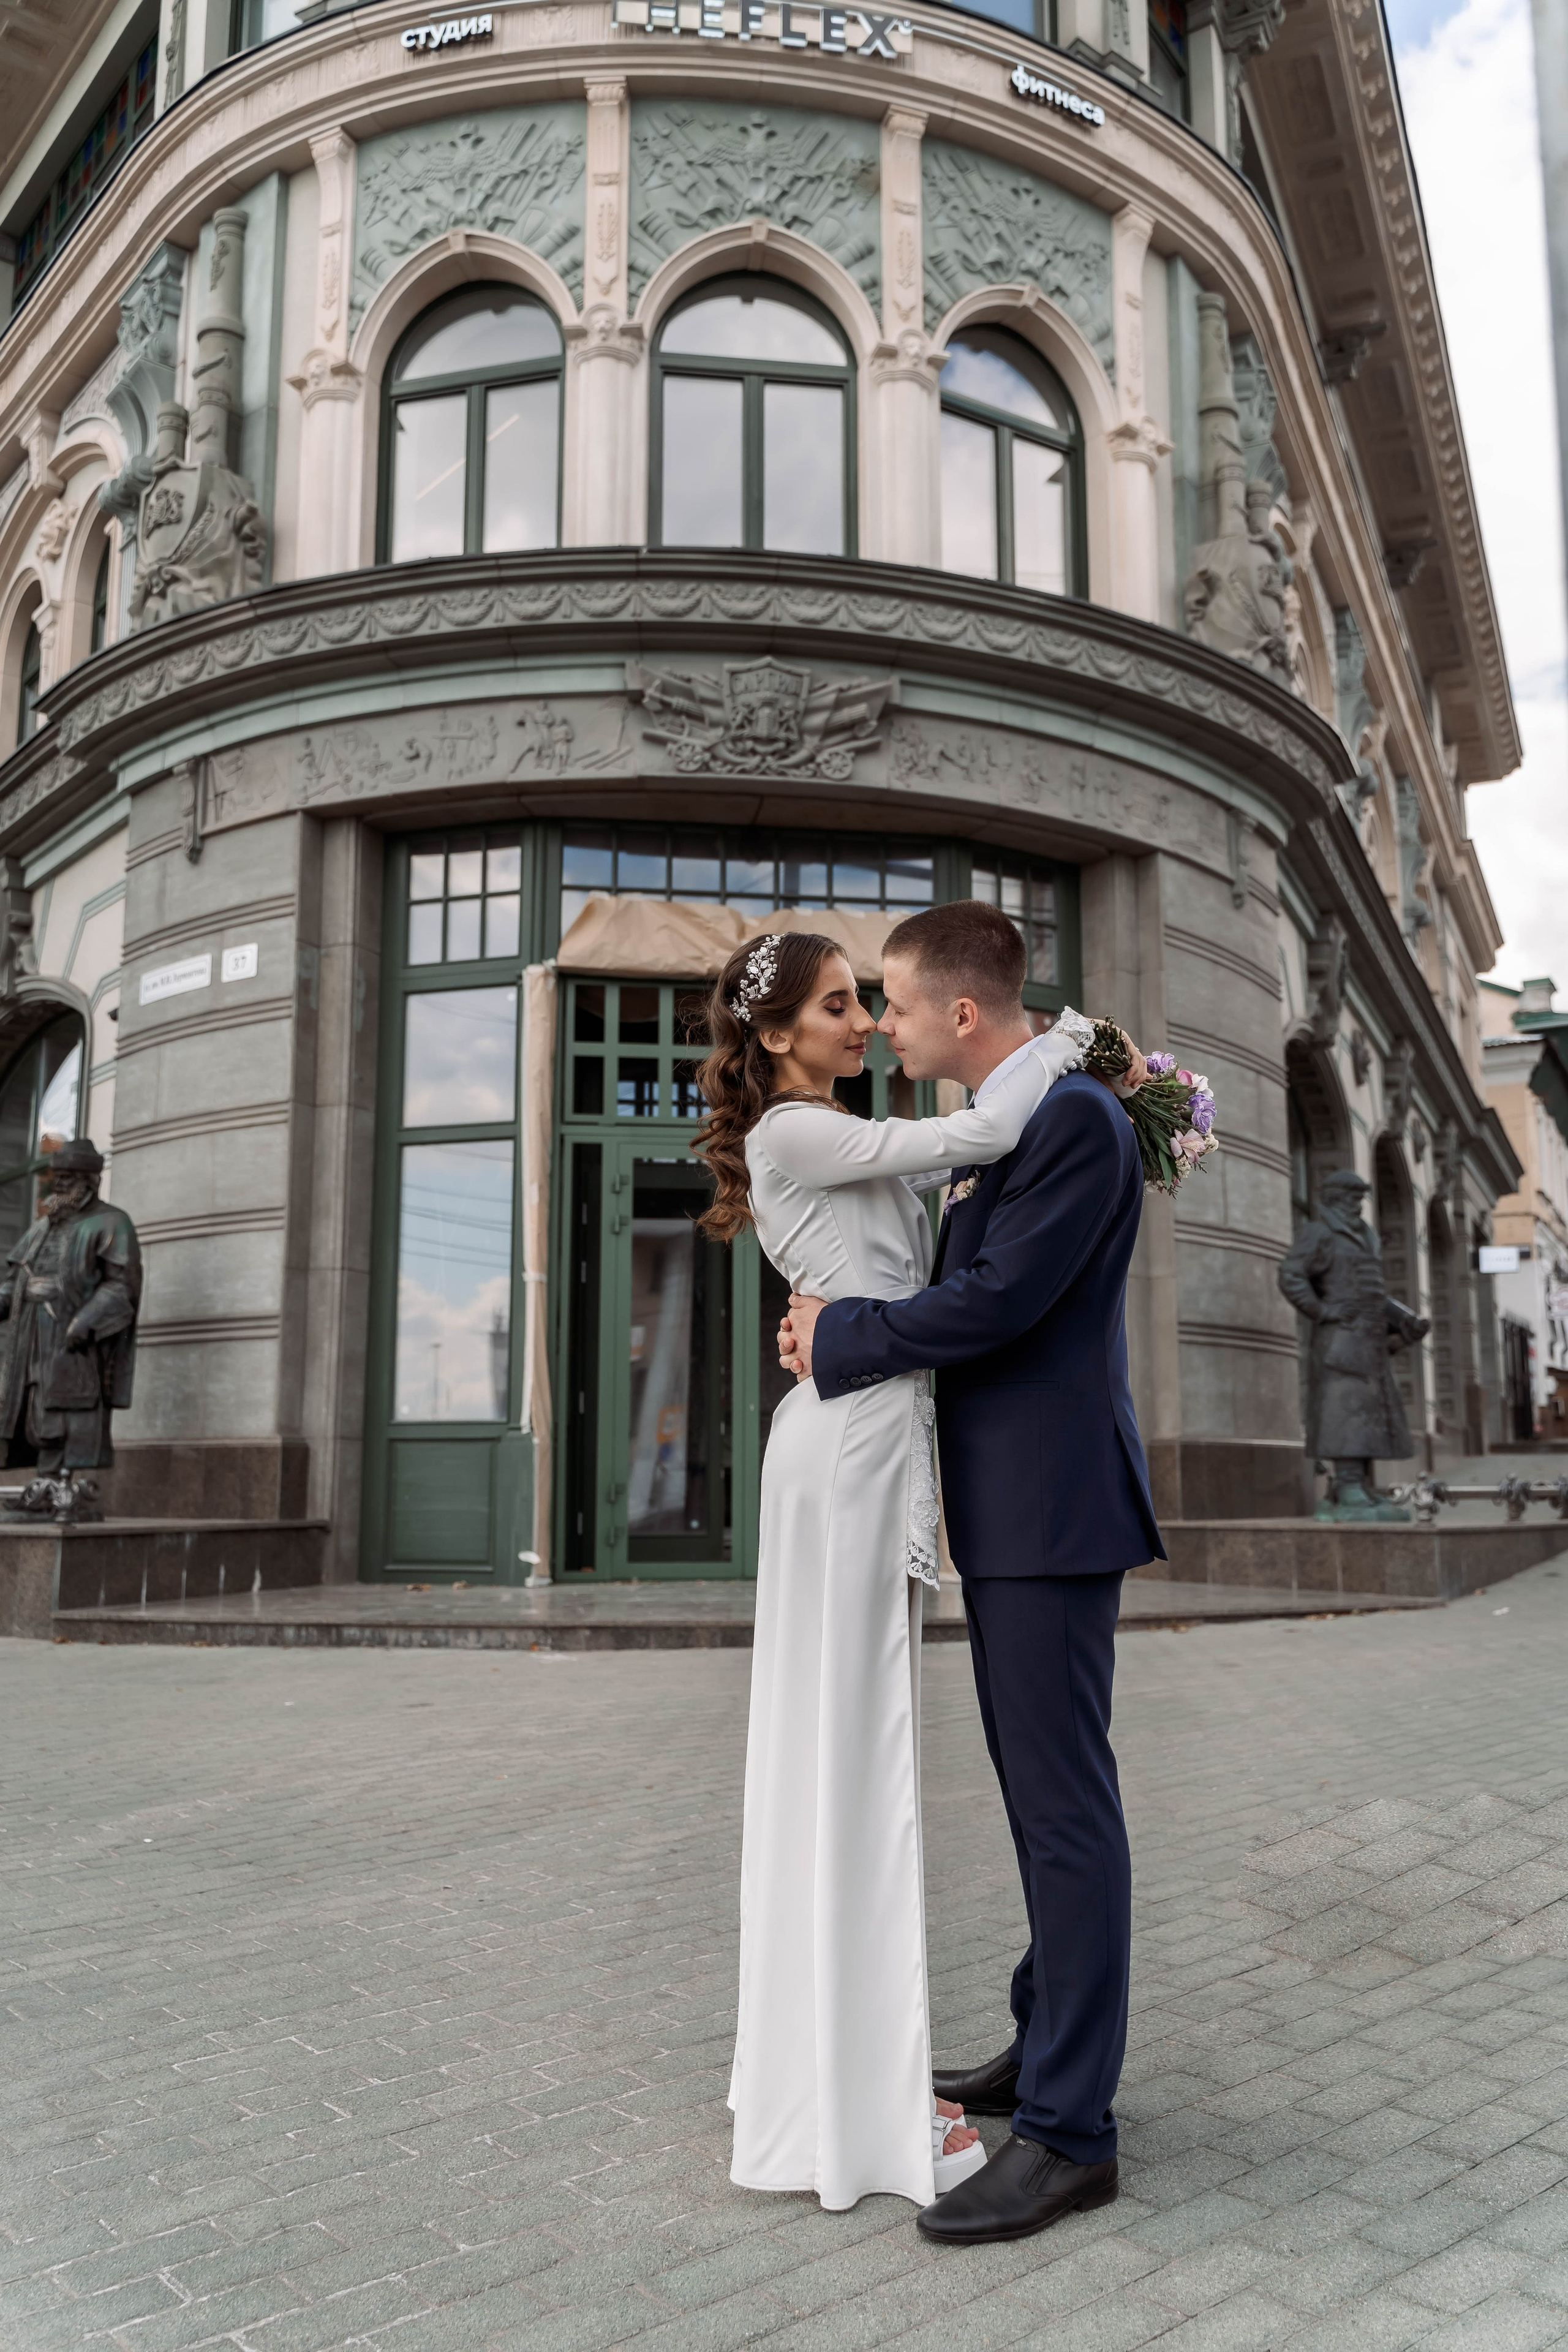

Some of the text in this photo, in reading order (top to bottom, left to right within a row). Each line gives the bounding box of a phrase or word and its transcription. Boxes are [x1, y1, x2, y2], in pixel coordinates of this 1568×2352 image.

[400, 13, 492, 48] студия
[1011, 64, 1105, 126] фитнеса
[232, 956, 247, 971] 37
